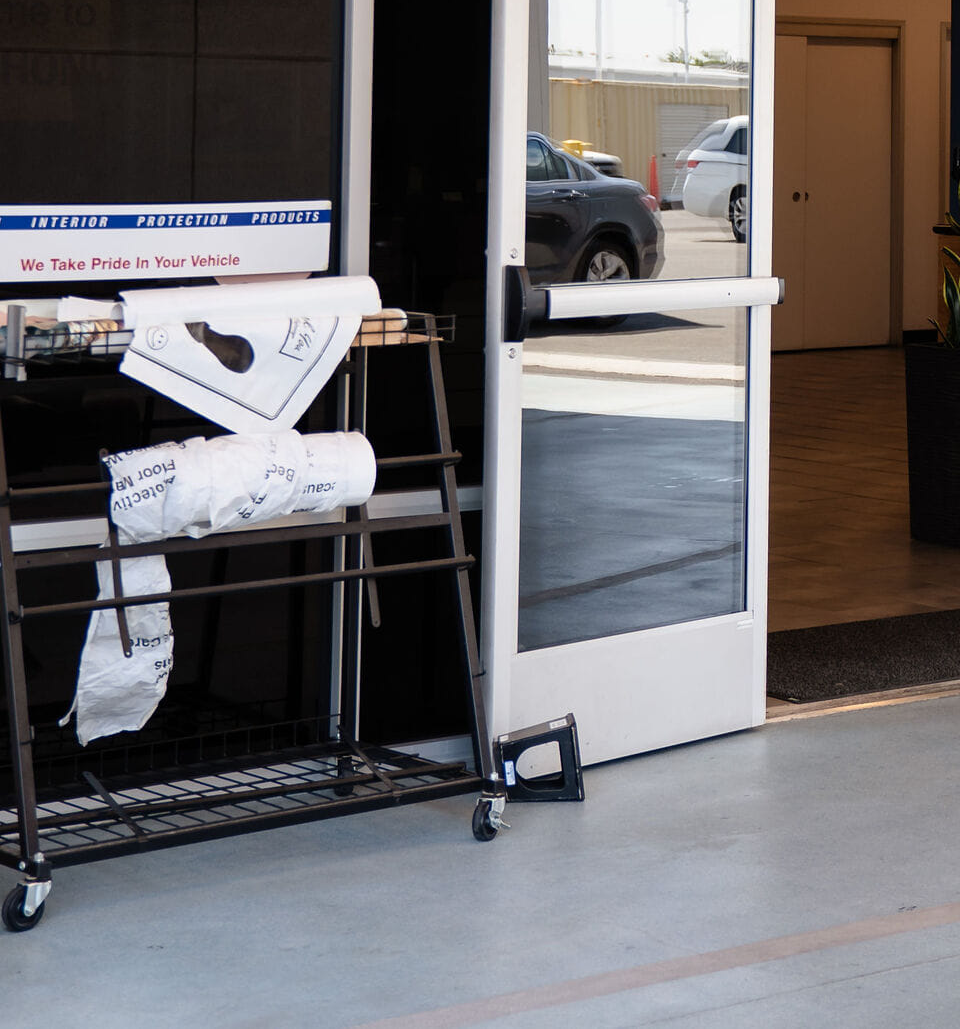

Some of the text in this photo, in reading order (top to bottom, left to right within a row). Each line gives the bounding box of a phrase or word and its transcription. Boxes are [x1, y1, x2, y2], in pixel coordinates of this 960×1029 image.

[30, 211, 320, 229] INTERIOR PROTECTION PRODUCTS
[20, 254, 240, 272] We Take Pride In Your Vehicle
[138, 459, 176, 481] Floor
